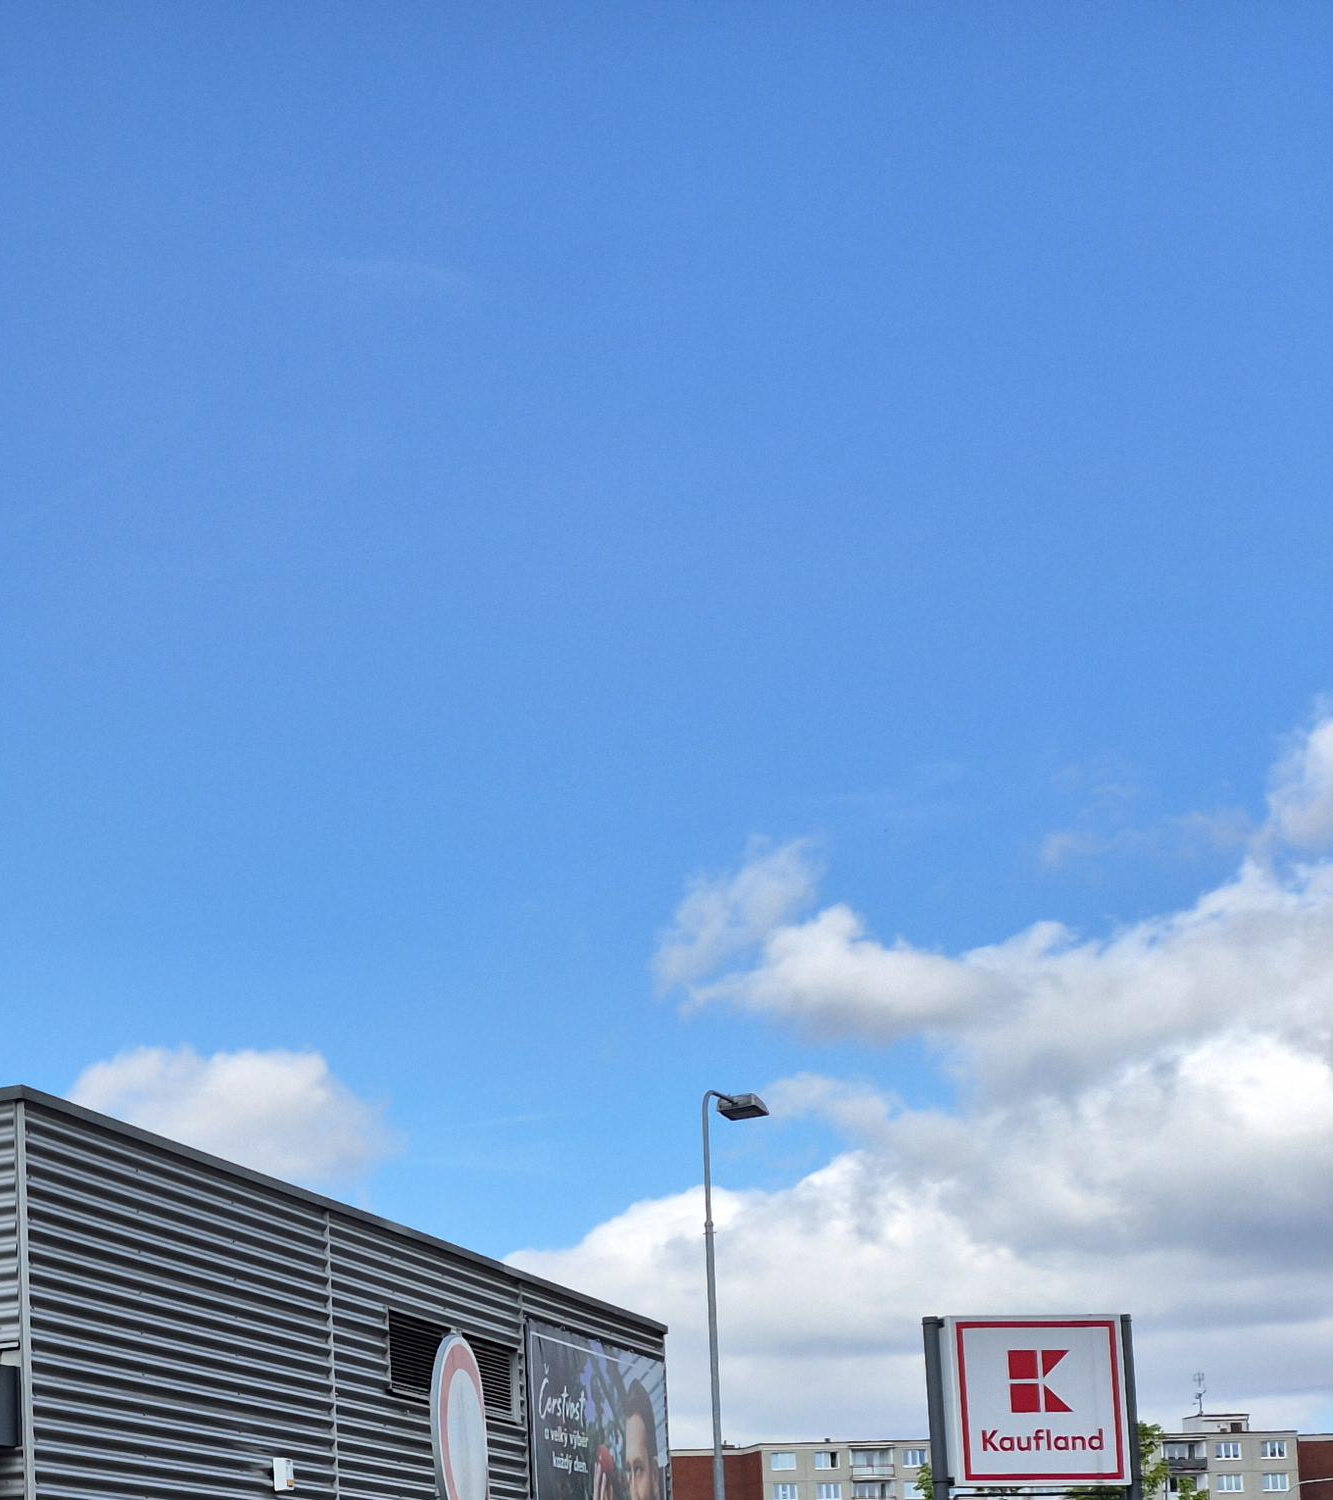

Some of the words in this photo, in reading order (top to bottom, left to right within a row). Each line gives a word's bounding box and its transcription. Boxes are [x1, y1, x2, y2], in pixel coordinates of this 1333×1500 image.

[539, 1363, 586, 1427] Čerstvost
[544, 1428, 550, 1440] a
[550, 1426, 568, 1448] velký
[569, 1430, 589, 1450] výběr
[981, 1428, 1104, 1452] Kaufland
[552, 1450, 573, 1475] každý
[573, 1456, 589, 1474] den.
